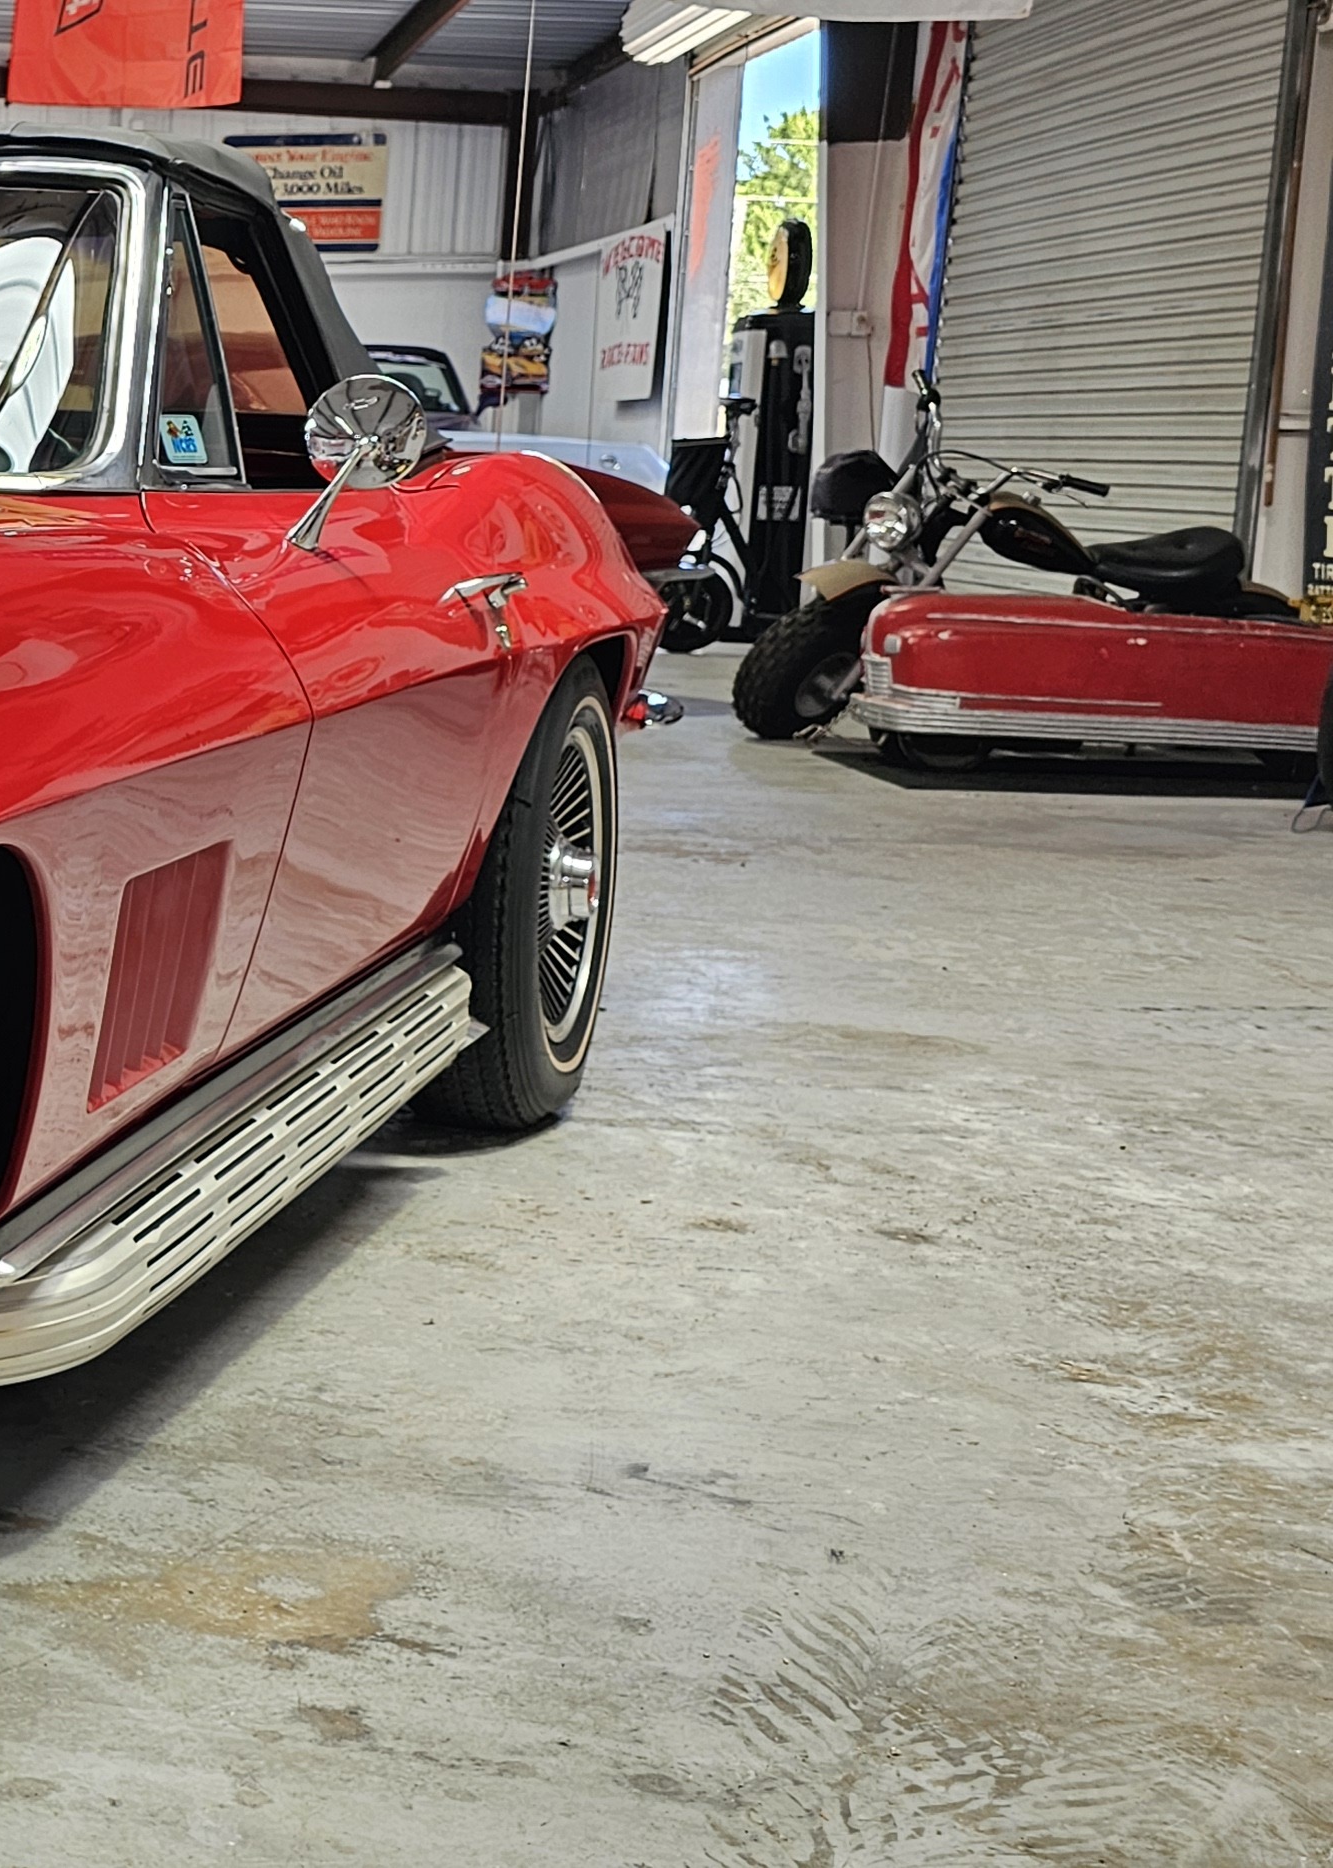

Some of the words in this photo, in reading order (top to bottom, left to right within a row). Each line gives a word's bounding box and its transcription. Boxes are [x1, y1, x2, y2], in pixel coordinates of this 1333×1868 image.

[320, 165, 344, 178] Oil
[322, 181, 364, 195] Miles
[602, 235, 662, 277] WELCOME
